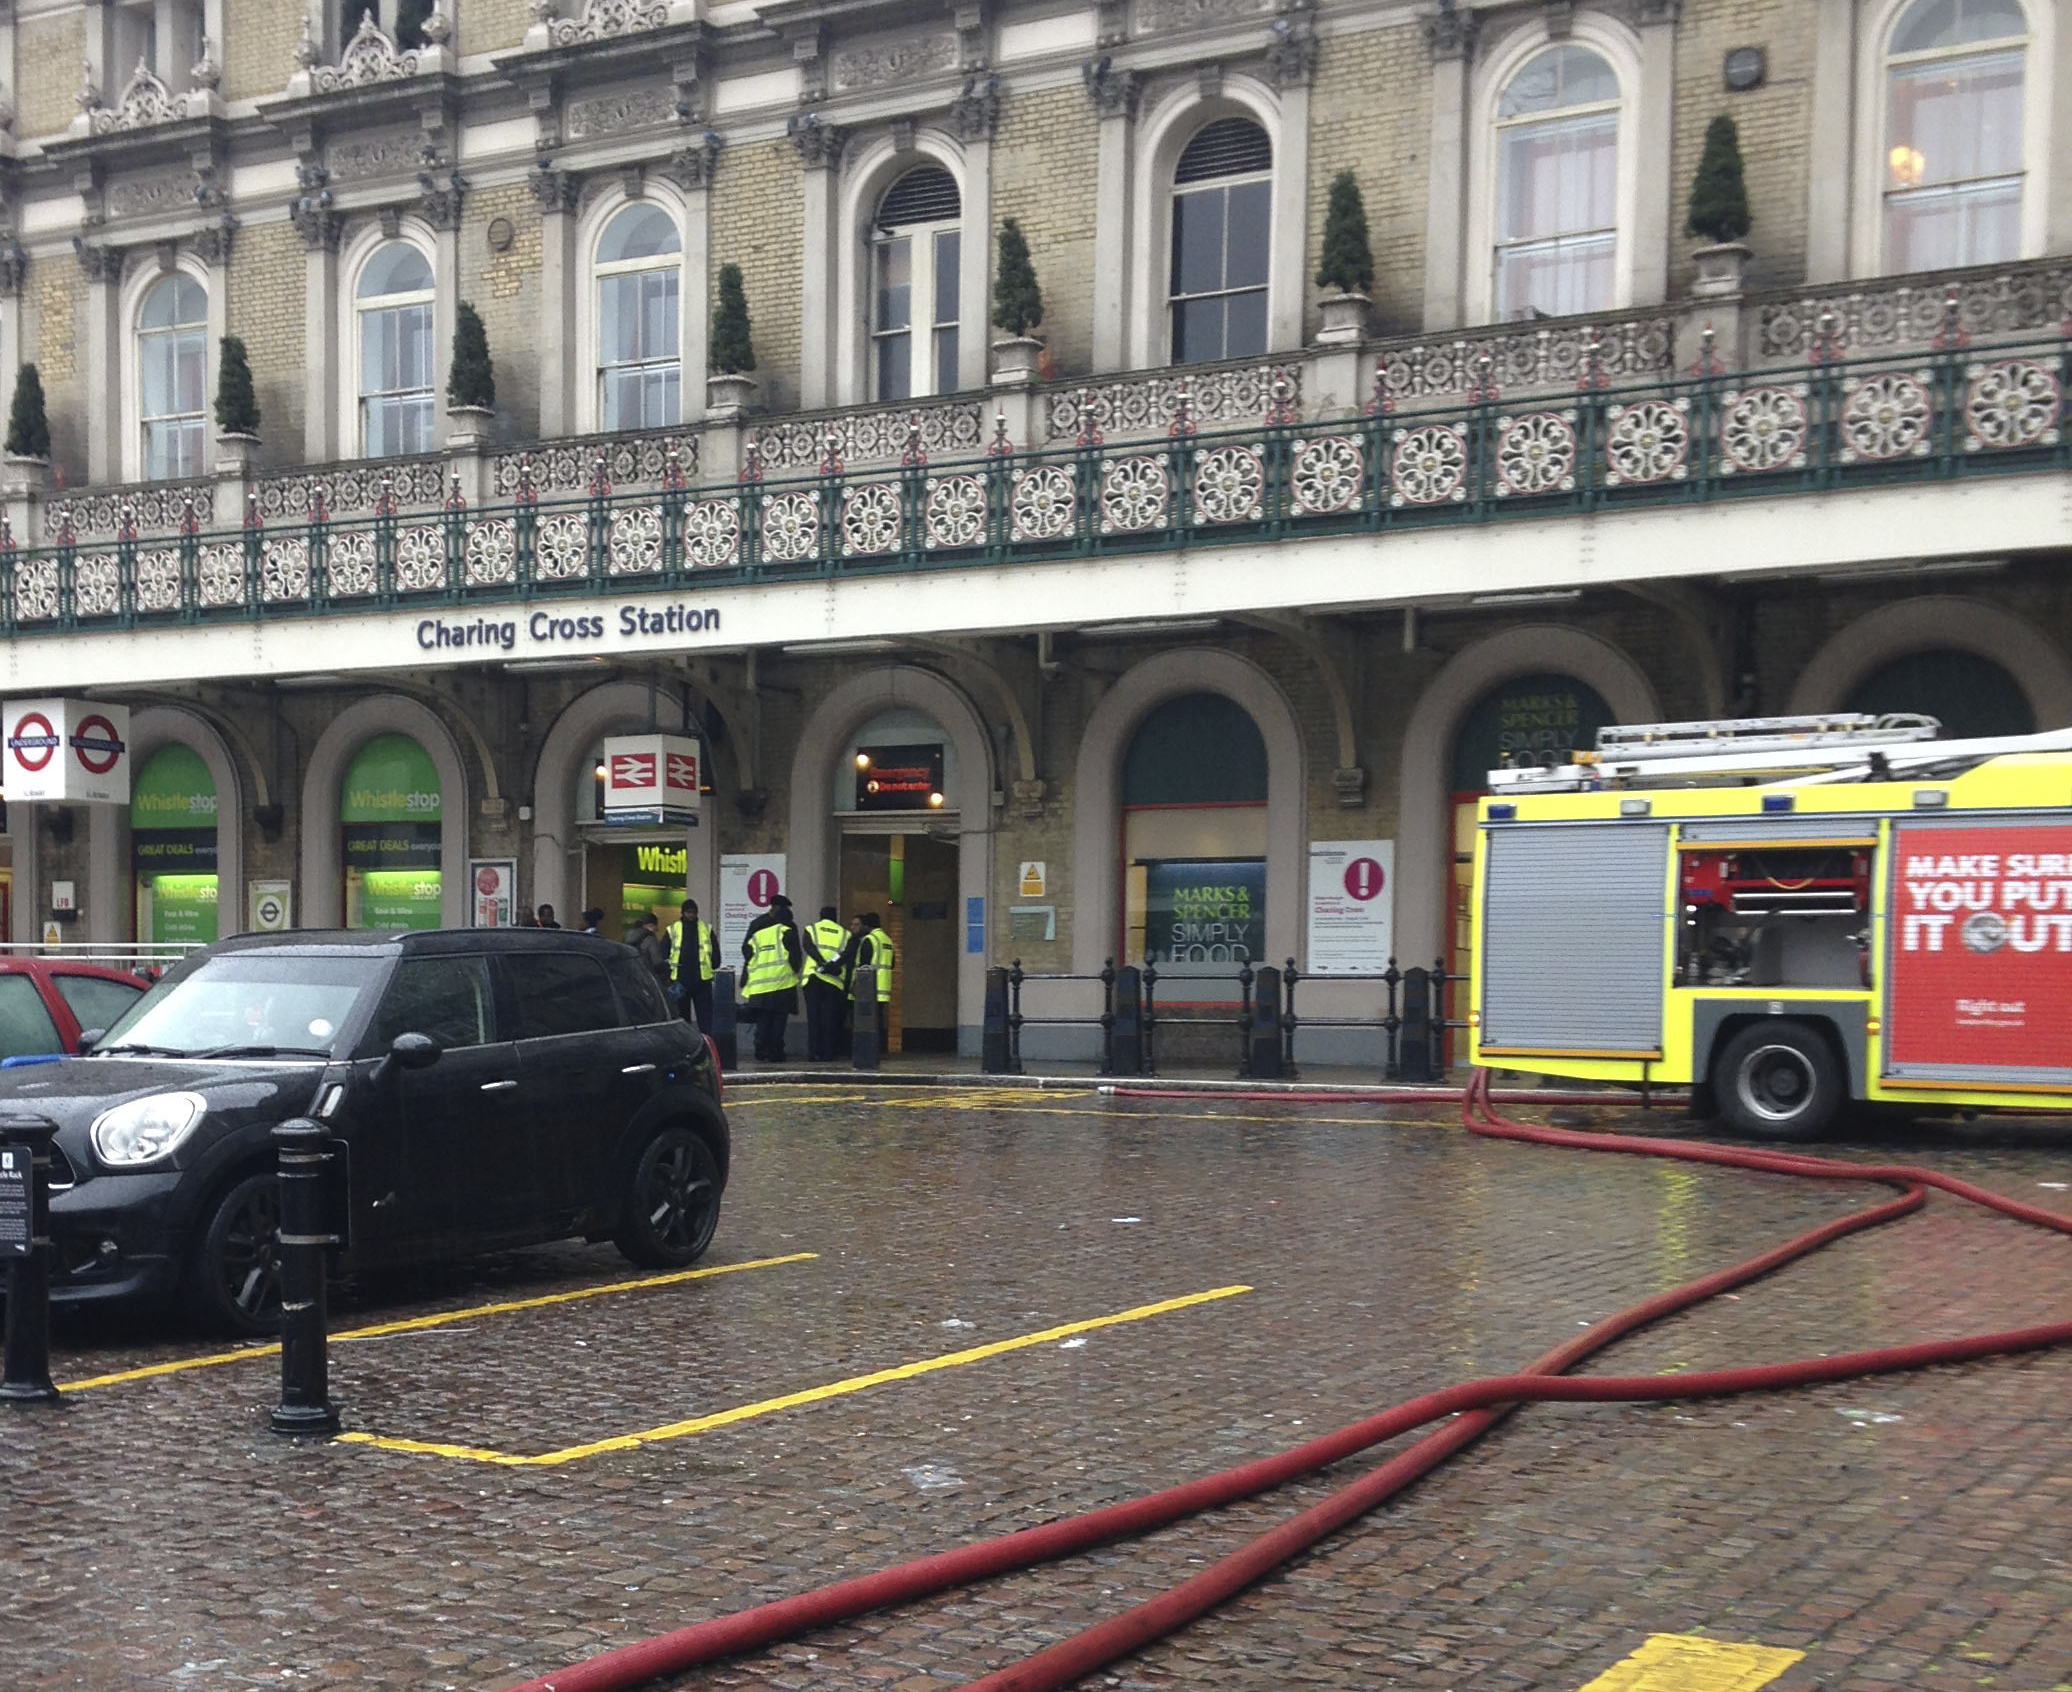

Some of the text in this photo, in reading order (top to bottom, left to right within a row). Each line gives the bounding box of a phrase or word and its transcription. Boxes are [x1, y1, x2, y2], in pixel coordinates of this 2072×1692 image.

[416, 604, 720, 649] Charing Cross Station
[349, 789, 440, 811] Whistlestop
[379, 839, 409, 852] DEALS
[1906, 854, 2000, 877] MAKE
[1174, 885, 1249, 902] MARKS &
[1905, 881, 1995, 911] YOU
[1174, 904, 1250, 920] SPENCER
[1172, 923, 1250, 942] SIMPLY
[1904, 914, 1956, 952] IT
[1172, 943, 1250, 963] FOOD
